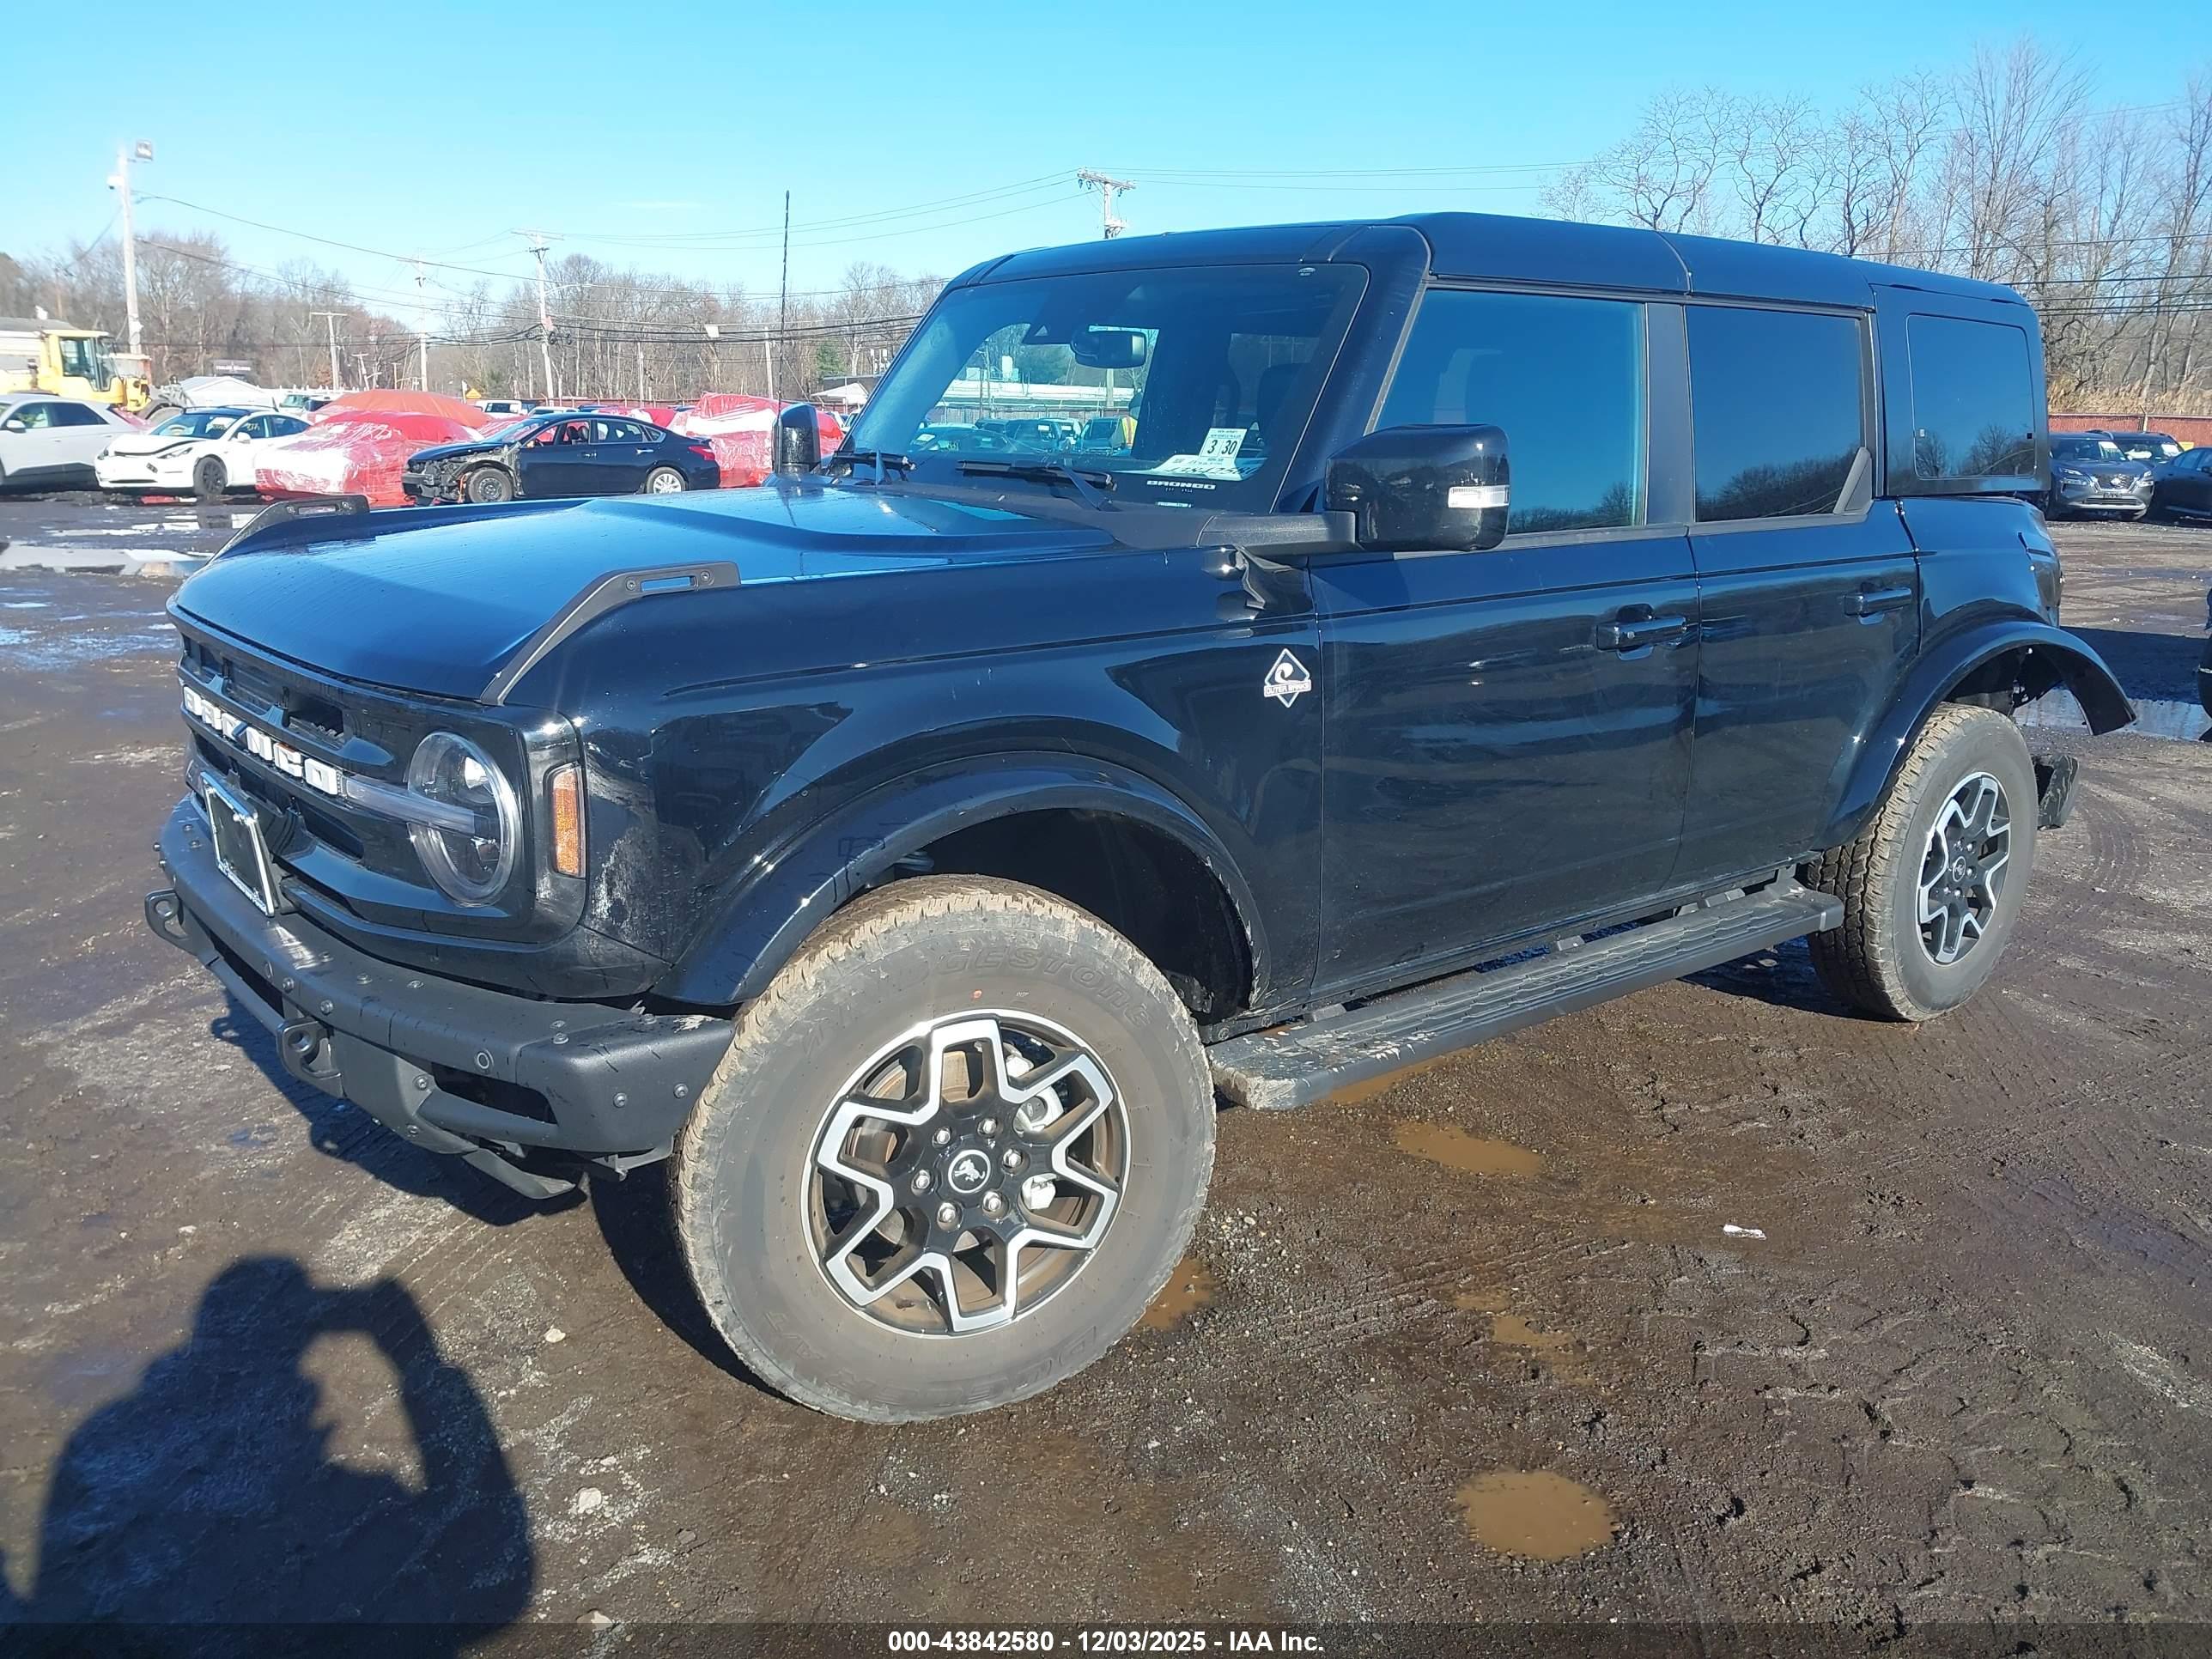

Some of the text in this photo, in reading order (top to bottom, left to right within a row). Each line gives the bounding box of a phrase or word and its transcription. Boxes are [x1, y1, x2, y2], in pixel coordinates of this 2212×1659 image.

[1207, 439, 1237, 455] 3 30
[1146, 480, 1216, 489] BRONCO
